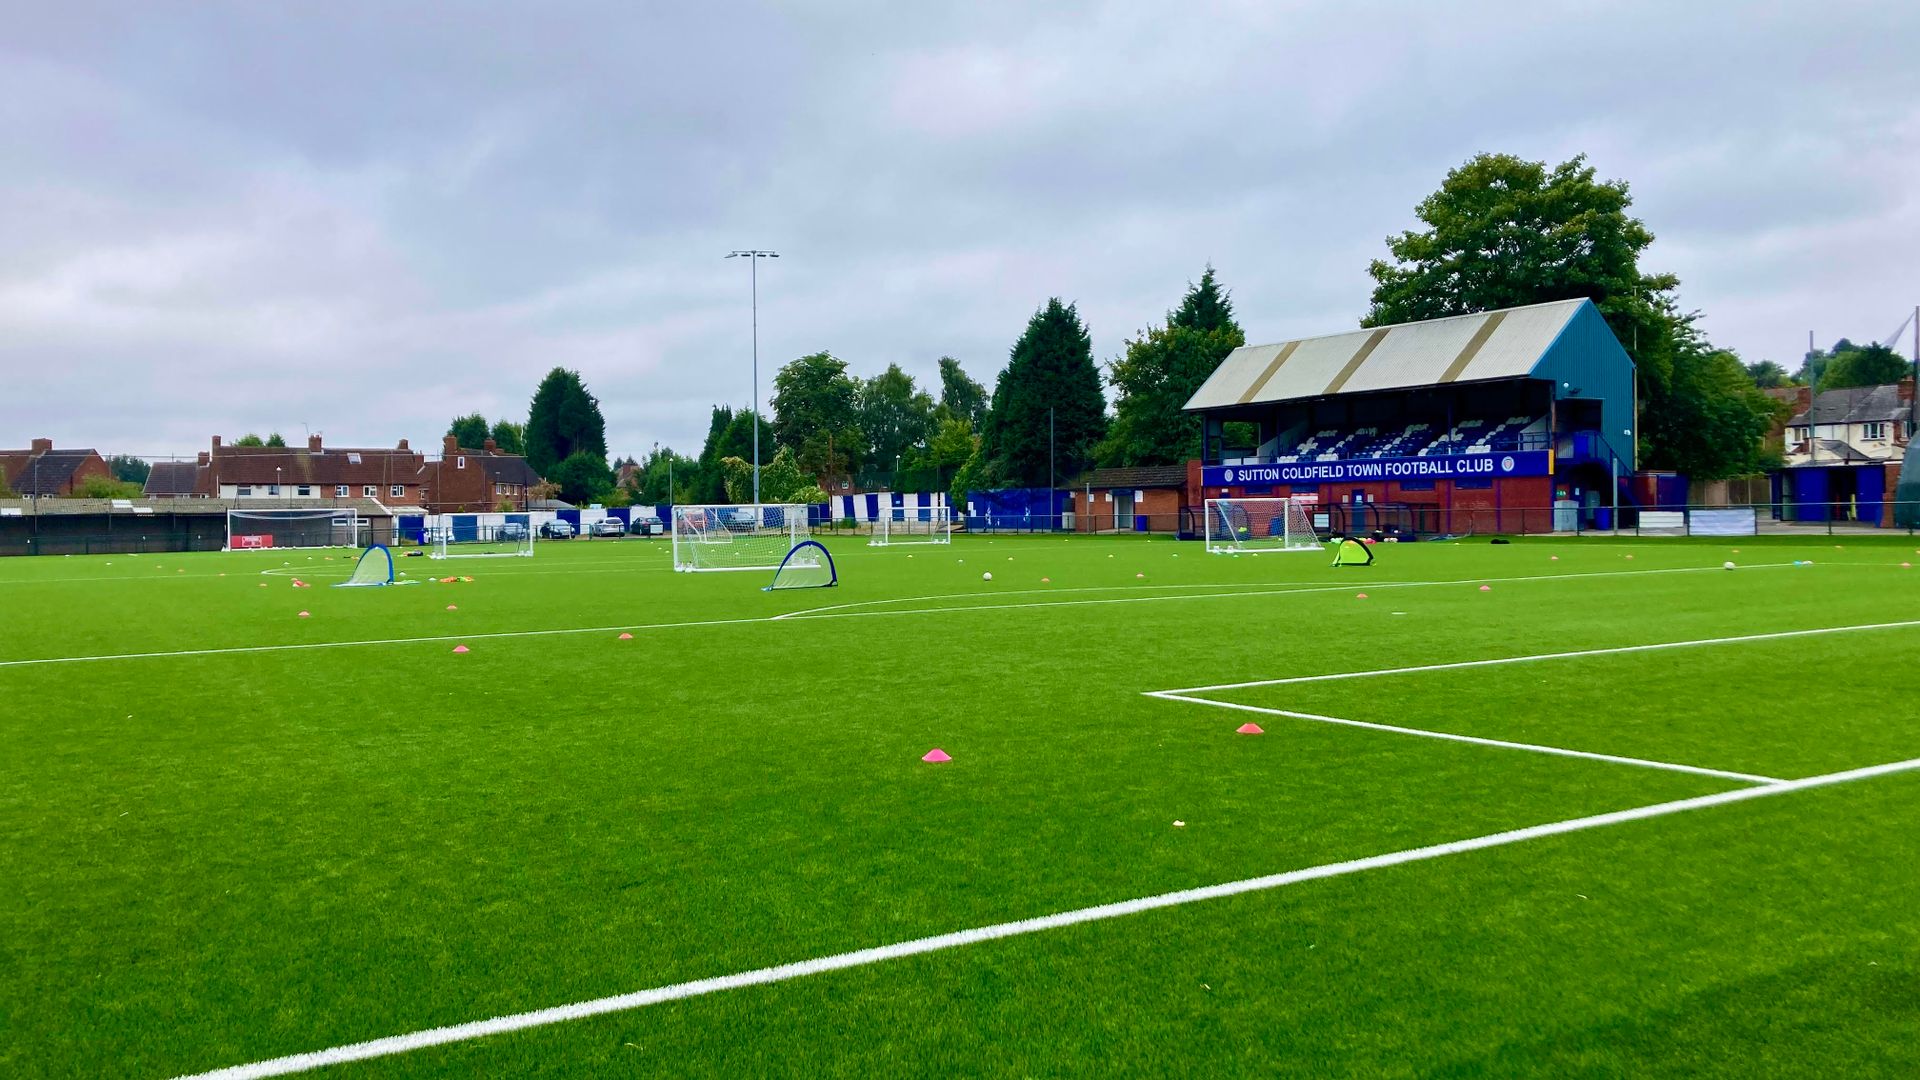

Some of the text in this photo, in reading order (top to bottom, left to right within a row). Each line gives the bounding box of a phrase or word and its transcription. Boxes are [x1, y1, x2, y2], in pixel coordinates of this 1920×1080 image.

[1238, 458, 1494, 481] SUTTON COLDFIELD TOWN FOOTBALL CLUB
